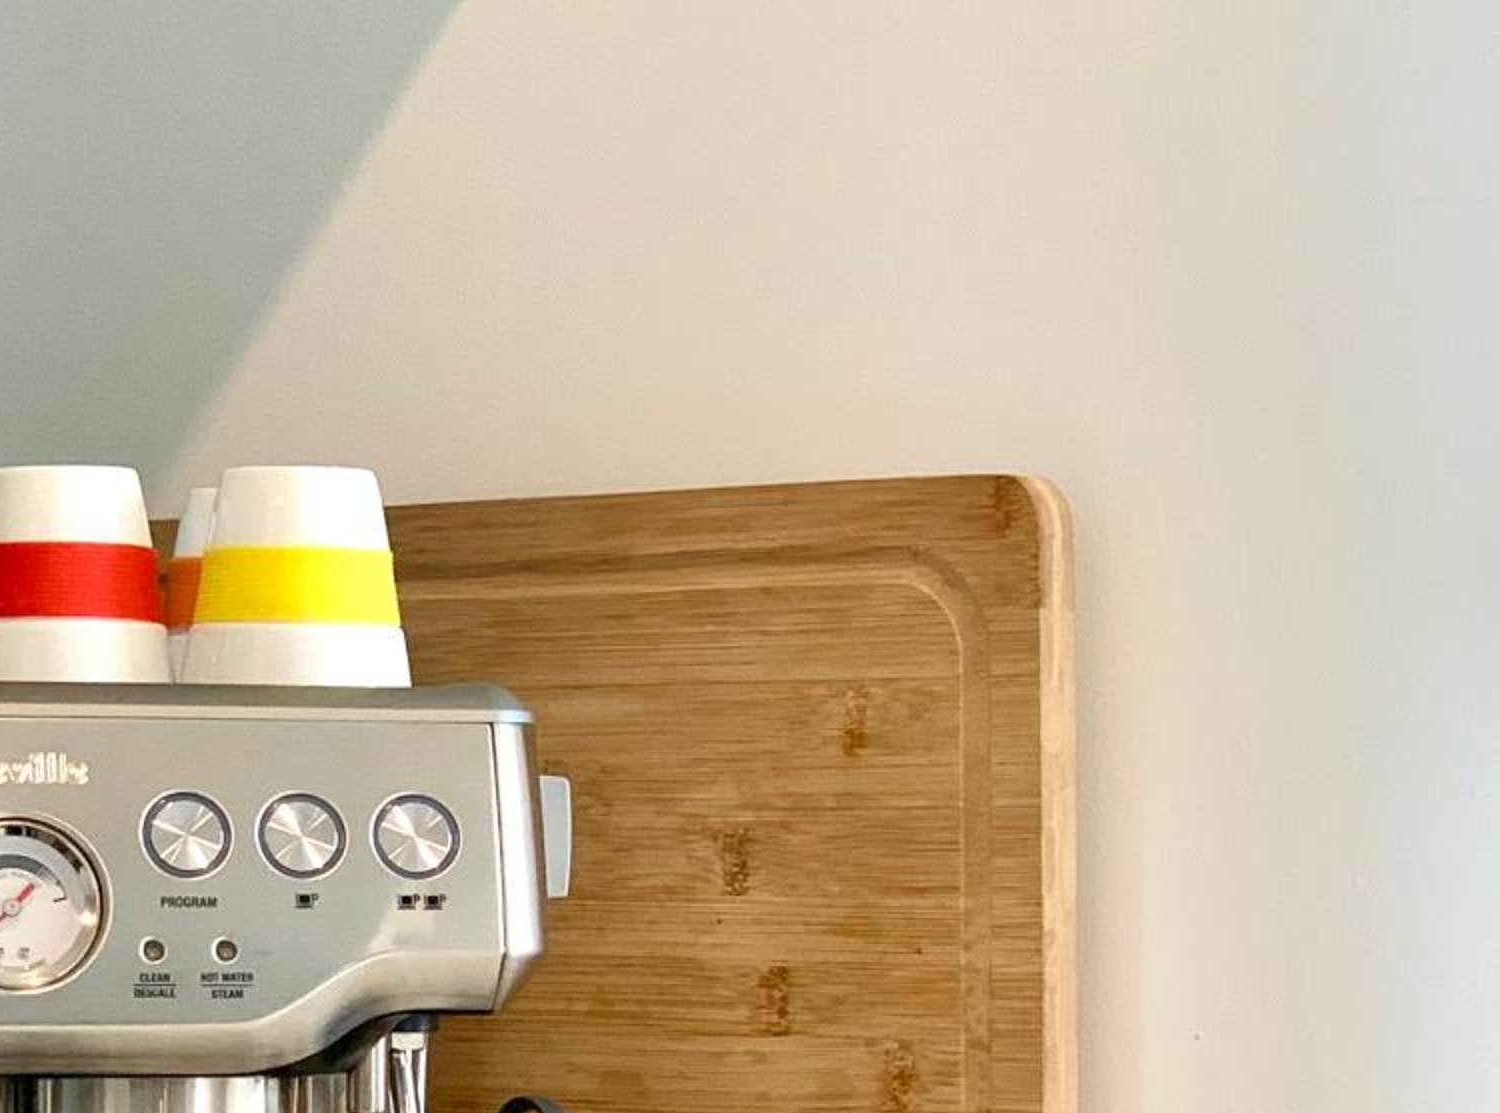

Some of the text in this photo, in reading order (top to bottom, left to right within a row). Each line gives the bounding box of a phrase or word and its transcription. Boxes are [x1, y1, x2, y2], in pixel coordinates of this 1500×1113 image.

[160, 896, 218, 908] PROGRAM
[139, 972, 171, 983] CLEAN
[211, 988, 245, 999] STEAM
